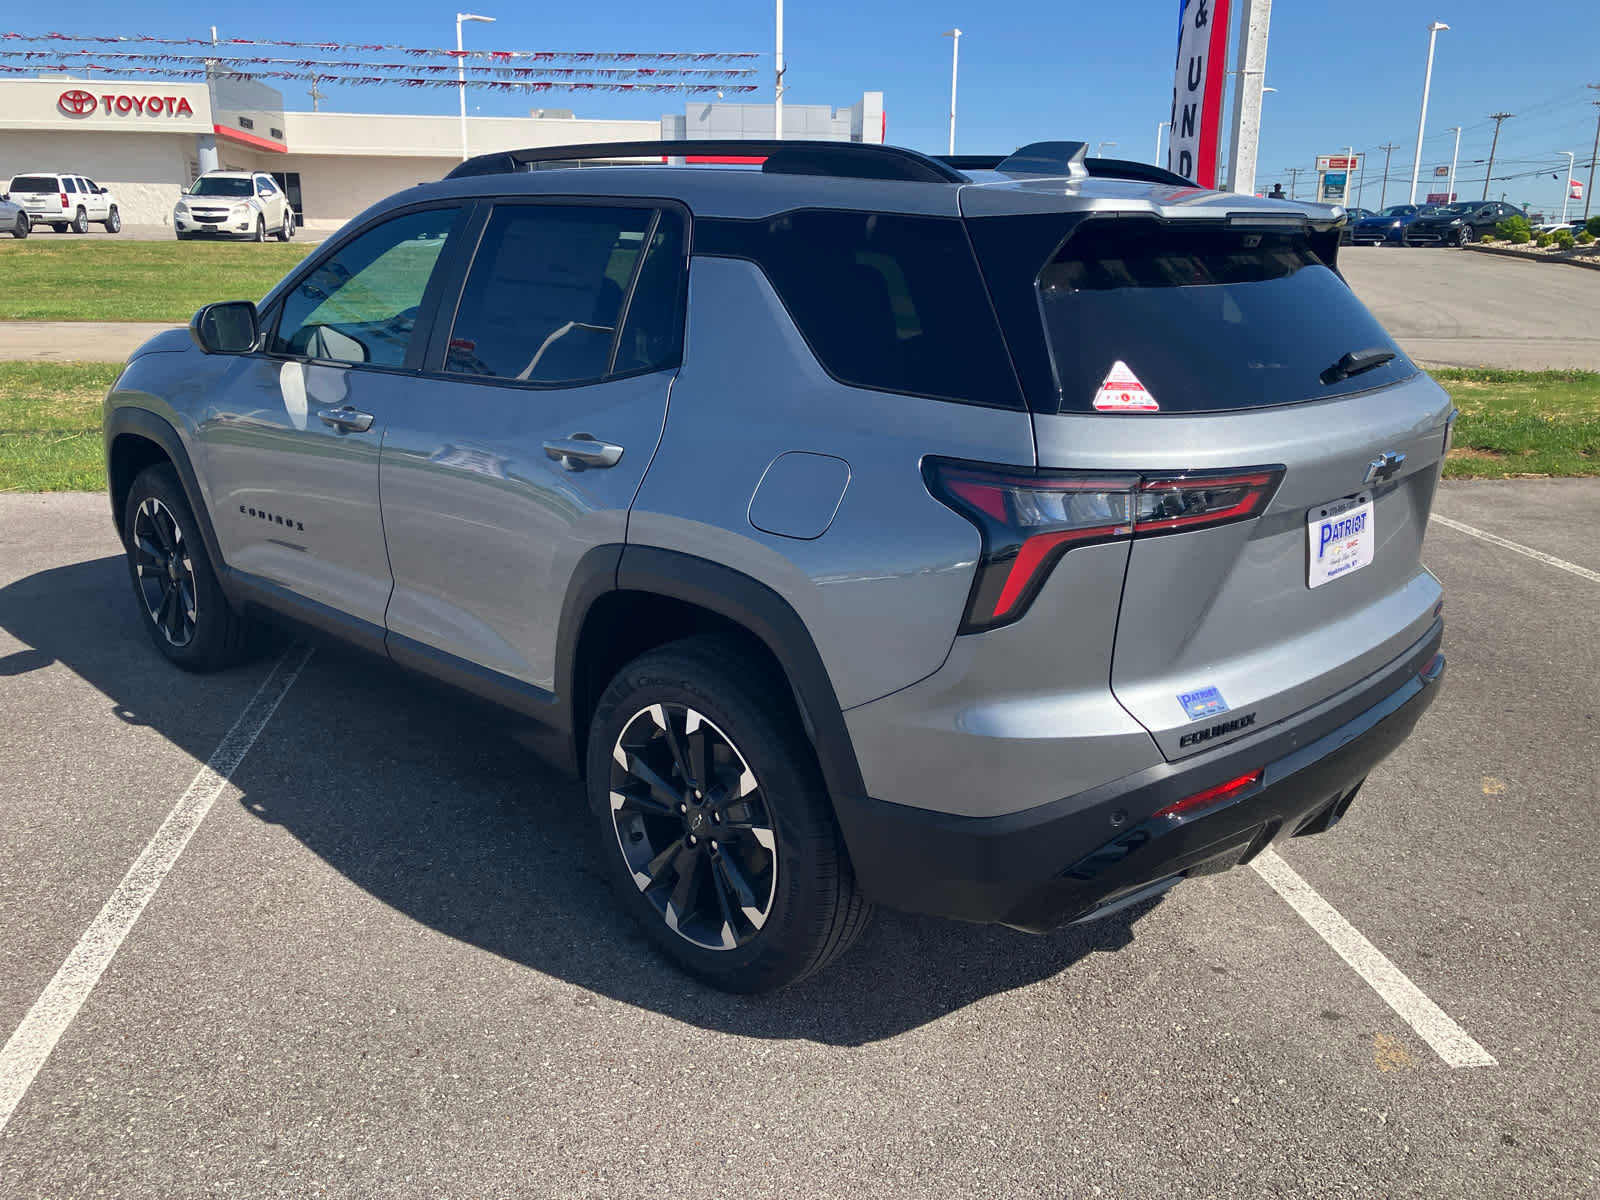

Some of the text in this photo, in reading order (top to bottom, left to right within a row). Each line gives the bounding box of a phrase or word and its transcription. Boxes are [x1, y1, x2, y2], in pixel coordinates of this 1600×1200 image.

[101, 94, 194, 115] TOYOTA
[1319, 512, 1368, 559] PATRIOT
[1179, 711, 1257, 749] EQUINOX
